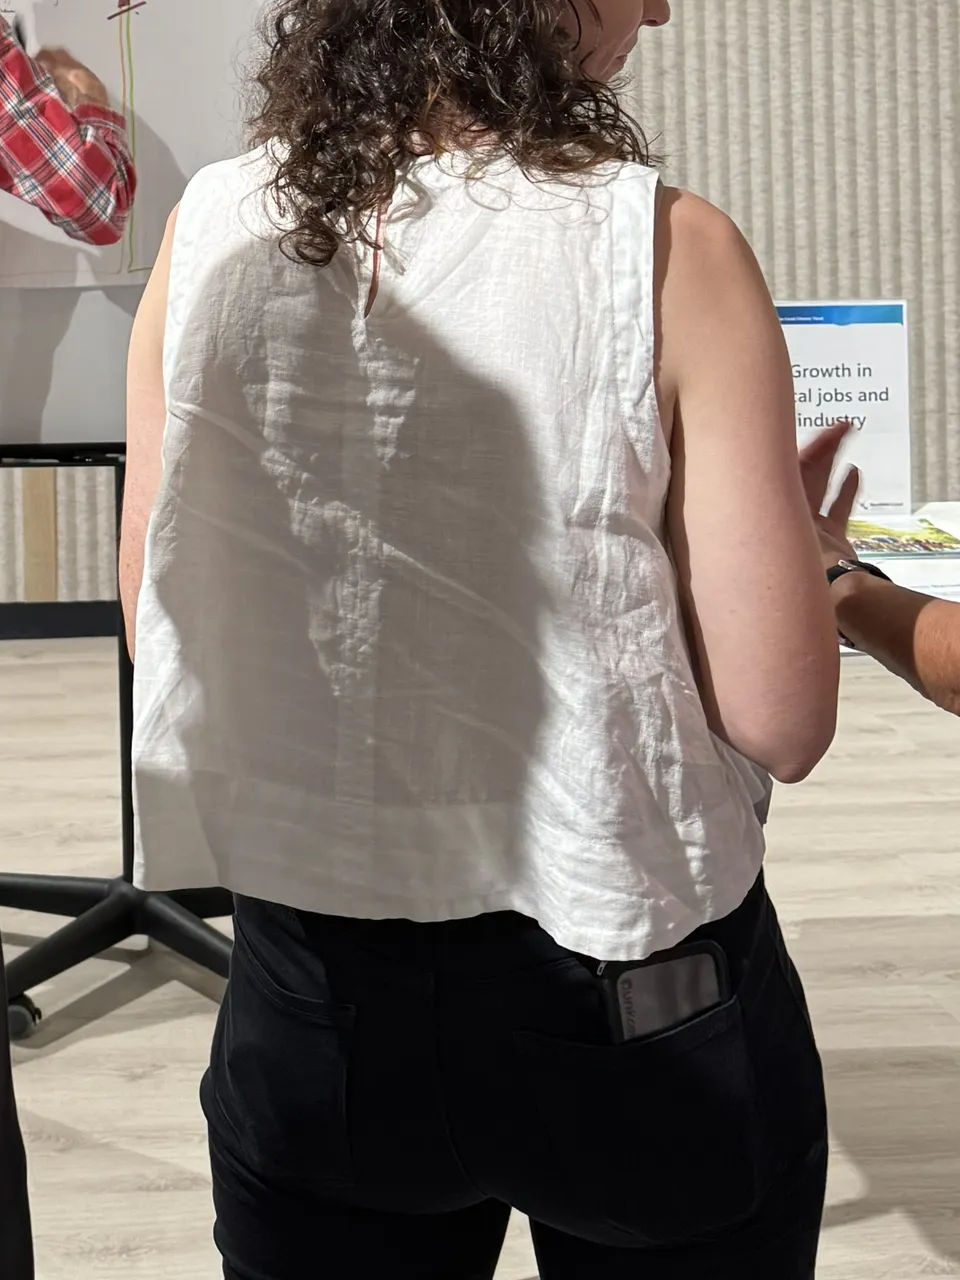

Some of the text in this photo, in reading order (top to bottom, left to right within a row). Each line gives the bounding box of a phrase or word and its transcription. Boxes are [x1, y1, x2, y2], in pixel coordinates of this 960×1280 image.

[791, 363, 873, 379] Growth in
[816, 388, 853, 407] jobs
[858, 387, 889, 402] and
